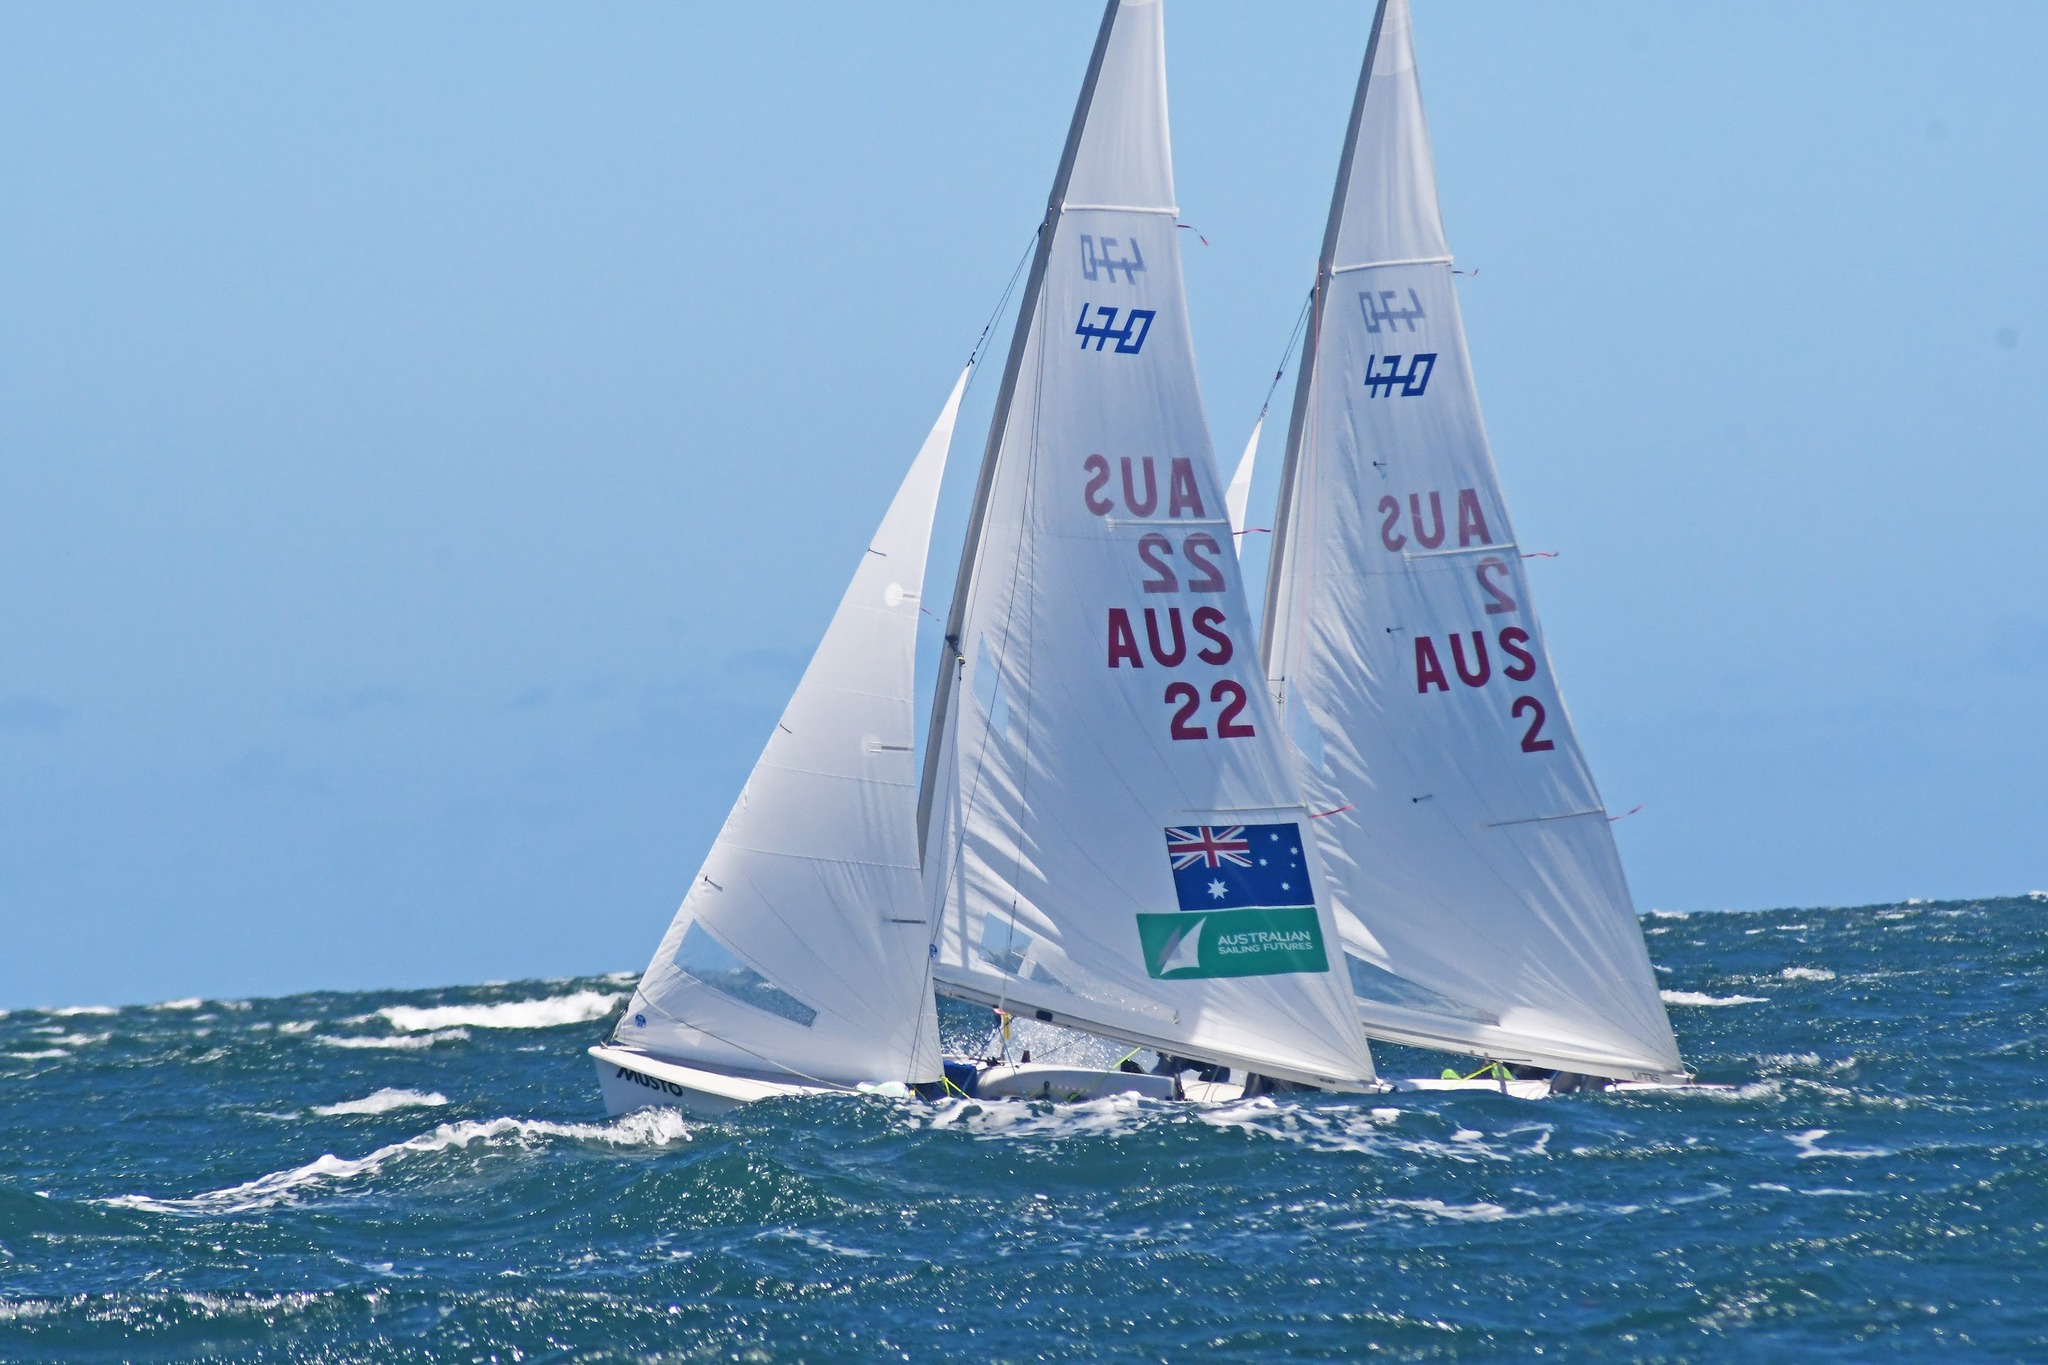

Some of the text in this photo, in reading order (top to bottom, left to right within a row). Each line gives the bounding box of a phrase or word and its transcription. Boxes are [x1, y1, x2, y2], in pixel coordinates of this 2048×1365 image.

[1075, 302, 1156, 354] 470
[1364, 353, 1437, 398] 470
[1108, 606, 1233, 668] AUS
[1414, 626, 1536, 693] AUS
[1164, 679, 1256, 741] 22
[1512, 695, 1554, 753] 2
[1218, 931, 1311, 945] AUSTRALIAN
[1218, 941, 1313, 955] SAILING FUTURES
[616, 1067, 683, 1097] MUSTO
